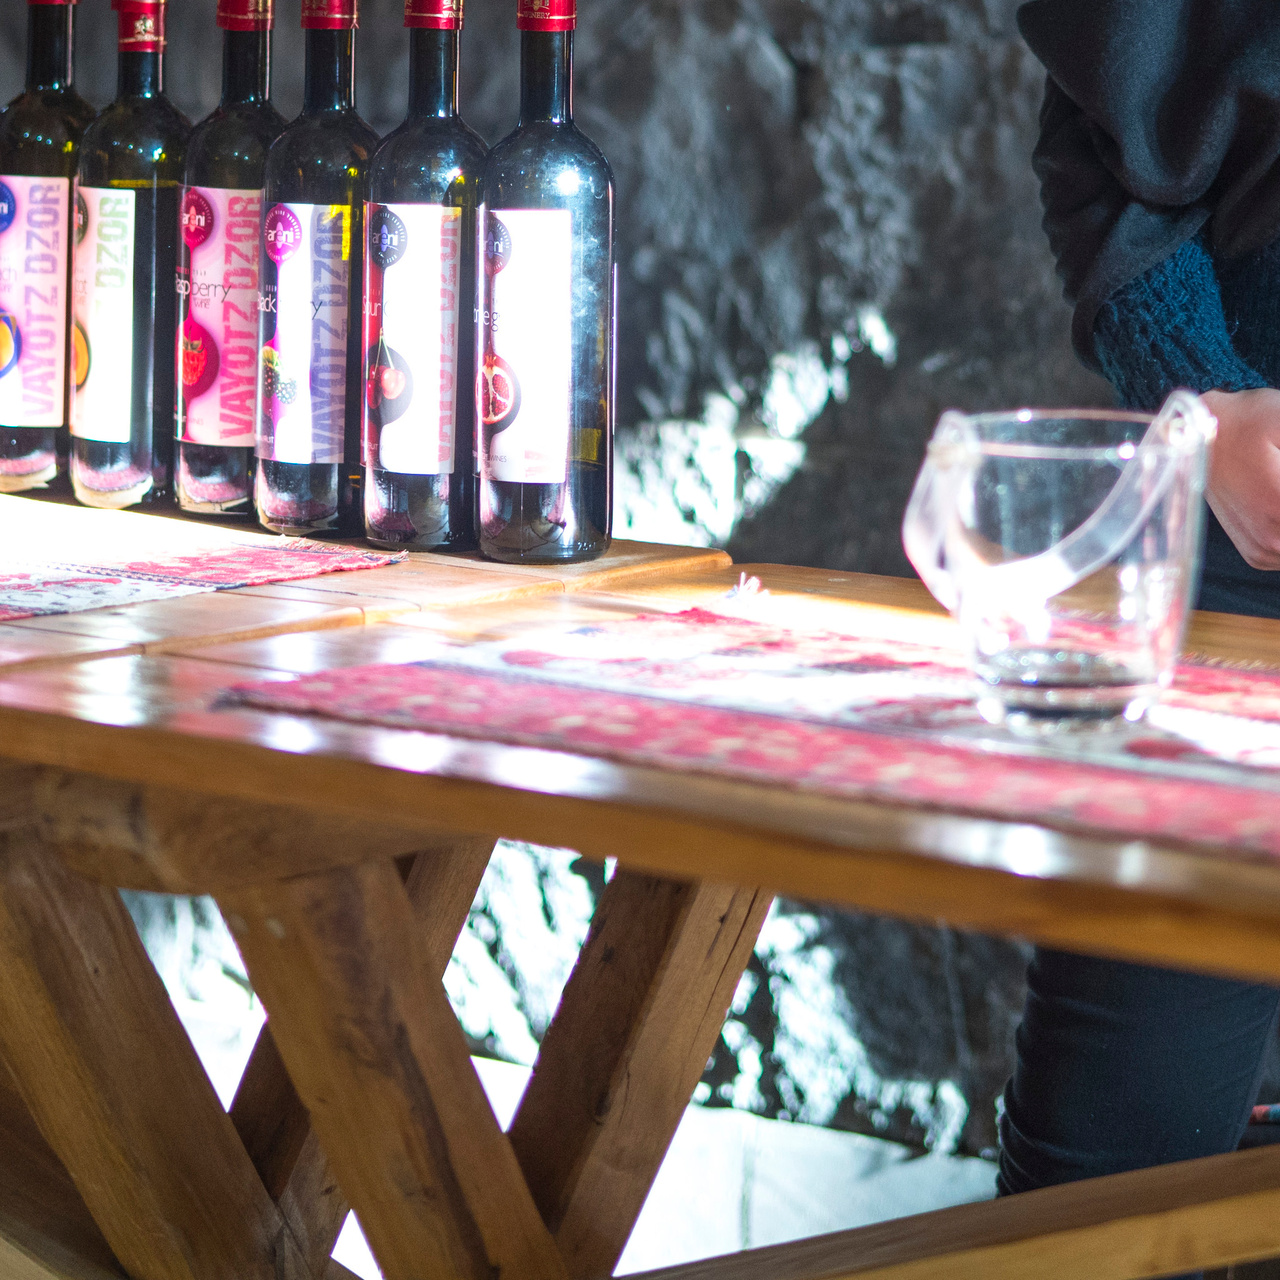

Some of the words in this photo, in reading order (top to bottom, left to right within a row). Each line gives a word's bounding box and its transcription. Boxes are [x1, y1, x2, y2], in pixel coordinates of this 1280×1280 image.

[25, 184, 60, 273] DZOR
[95, 196, 129, 289] DZOR
[183, 211, 206, 228] areni
[223, 195, 260, 289] DZOR
[267, 227, 295, 243] areni
[372, 230, 399, 246] areni
[23, 286, 58, 417] VAYOTZ
[219, 300, 258, 439] VAYOTZ
[310, 319, 347, 460] VAYOTZ
